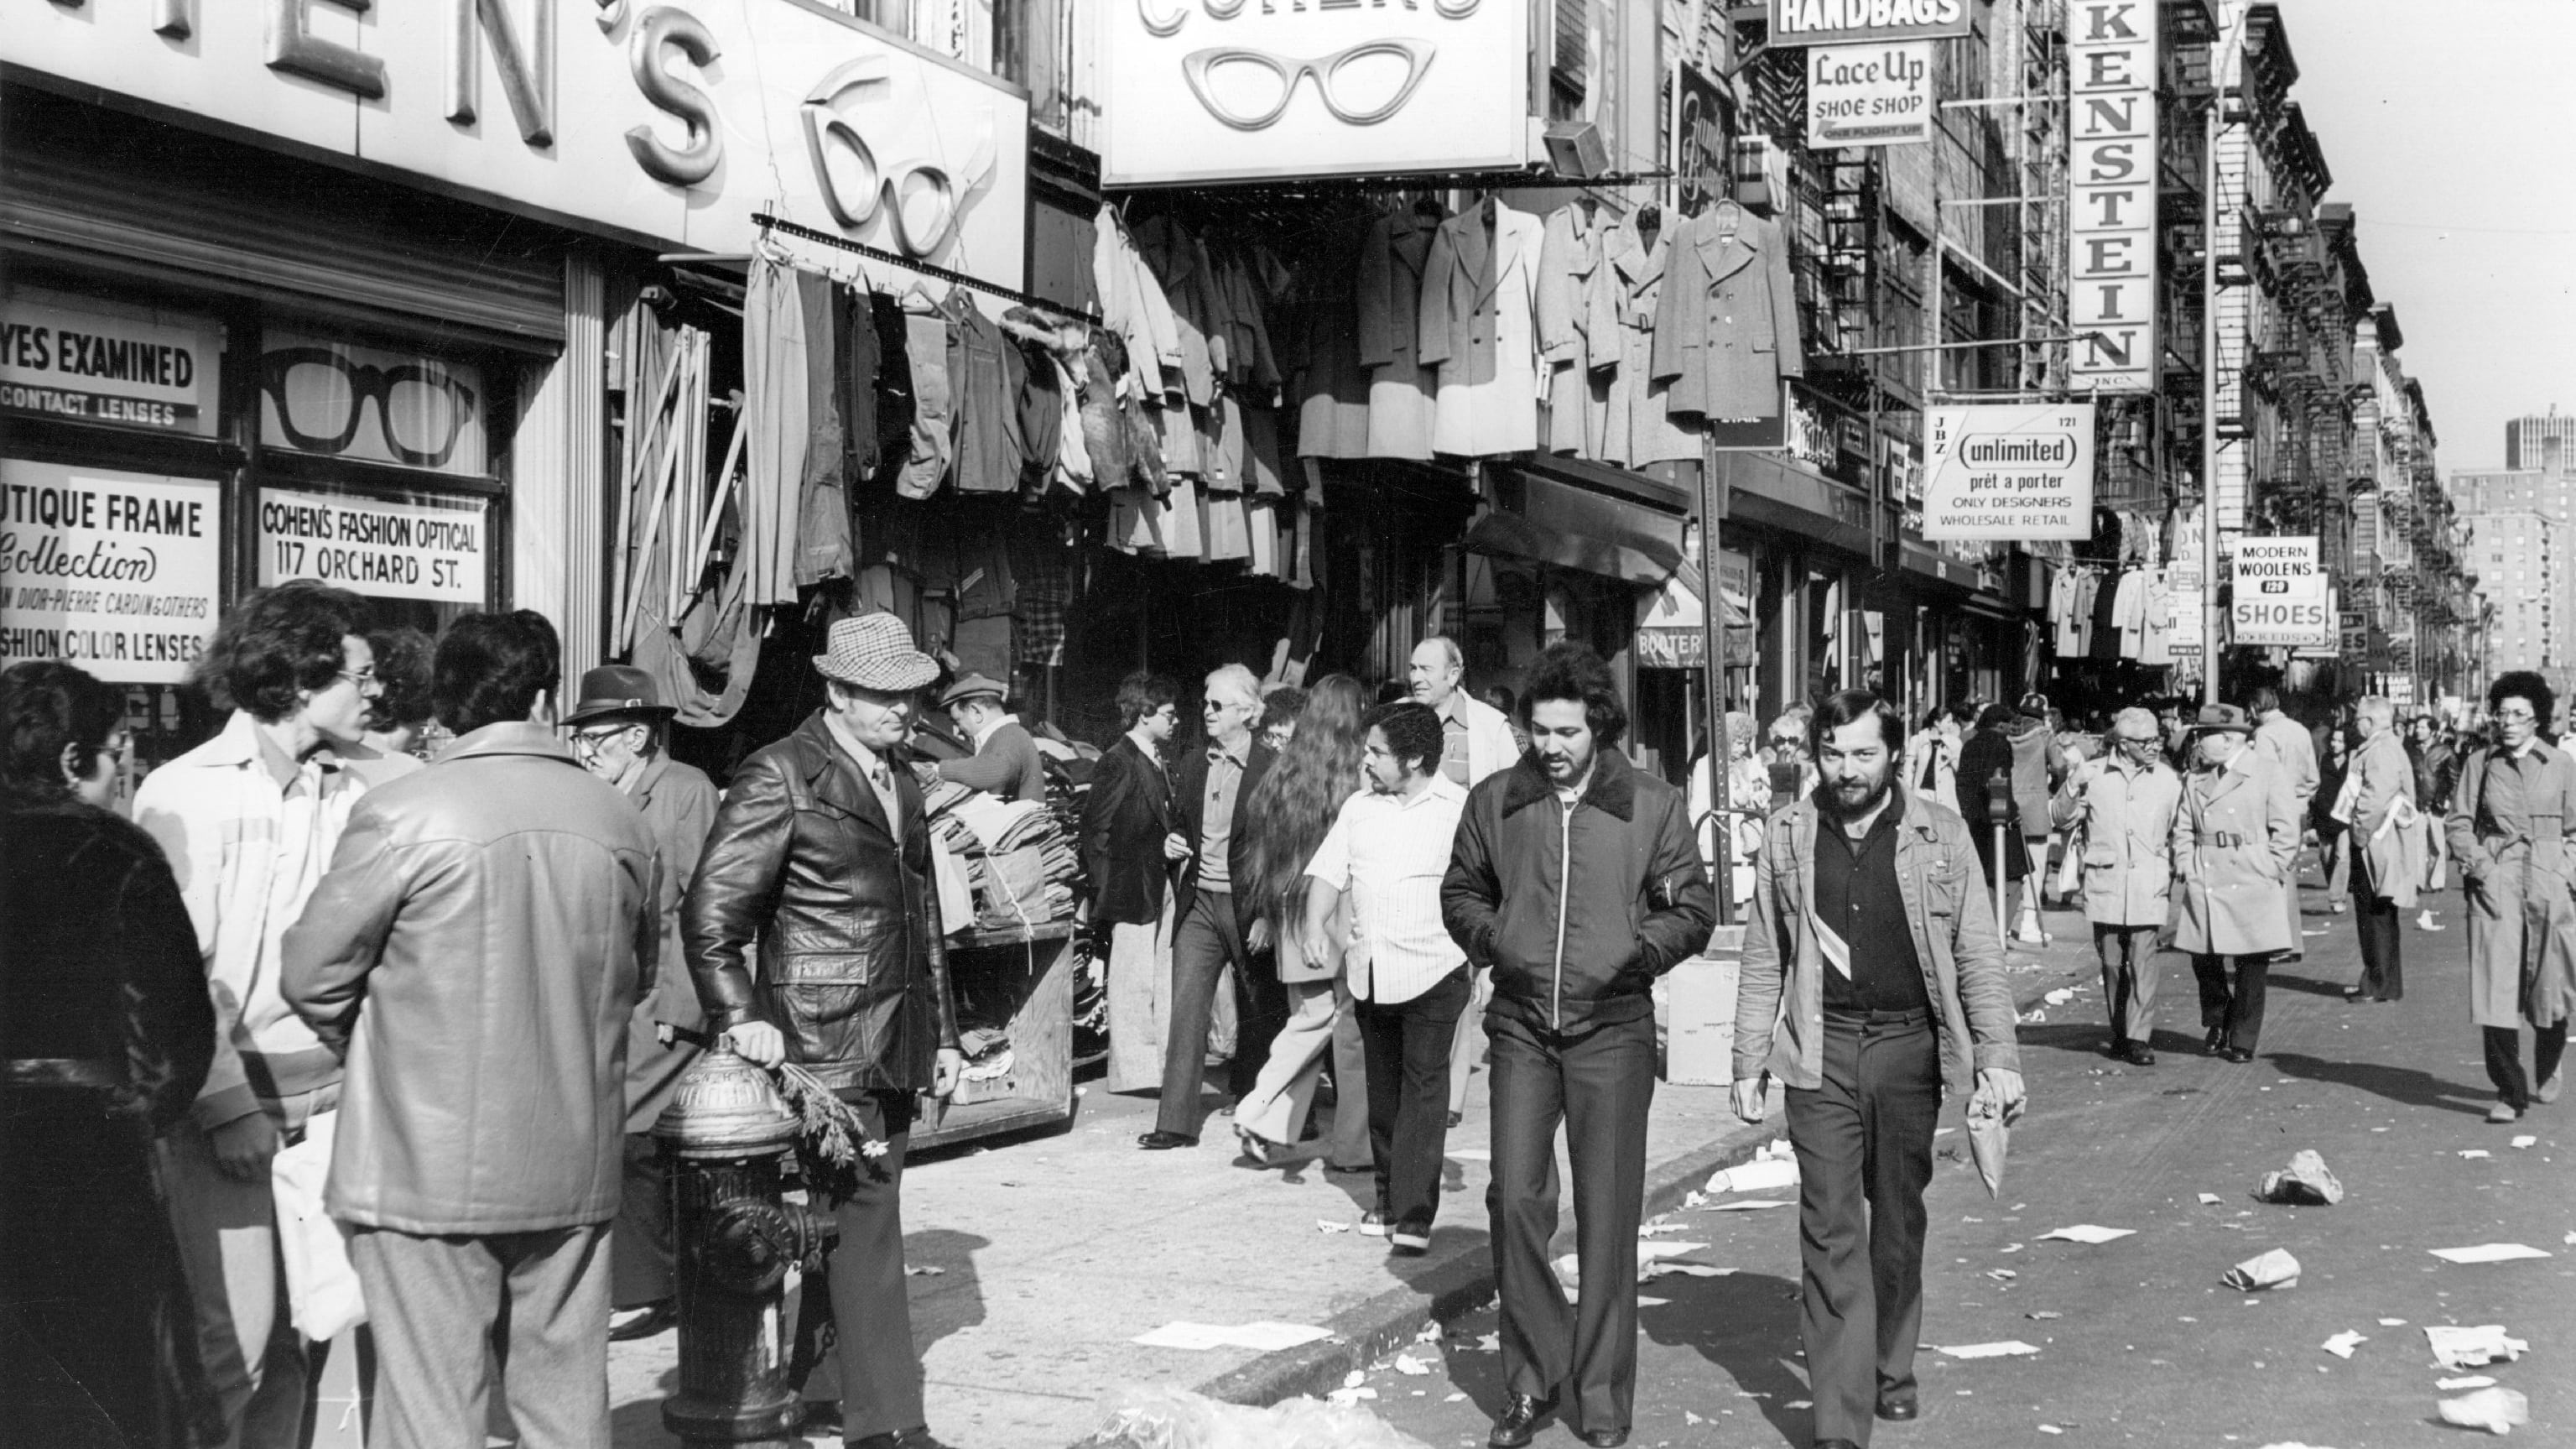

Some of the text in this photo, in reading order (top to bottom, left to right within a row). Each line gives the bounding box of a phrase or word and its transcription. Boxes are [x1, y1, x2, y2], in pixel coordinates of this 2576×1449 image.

[1779, 0, 1961, 32] HANDBAGS
[1814, 51, 1923, 91] Lace Up
[1814, 94, 1923, 118] SHOE SHOP
[59, 331, 193, 388] EXAMINED
[1, 386, 174, 425] CONTACT LENSES
[2059, 417, 2076, 427] 121
[2005, 476, 2012, 488] a
[2018, 474, 2063, 492] porter
[107, 494, 202, 537] FRAME
[1952, 497, 2072, 508] ONLY DESIGNERS
[262, 502, 477, 552] COHEN'S FASHION OPTICAL
[1940, 514, 2070, 526] WHOLESALE RETAIL
[0, 530, 157, 582] Collection
[277, 540, 461, 588] 117 ORCHARD ST.
[2242, 546, 2308, 558] MODERN
[2239, 562, 2311, 576] WOOLENS
[2236, 604, 2323, 624] SHOES
[65, 630, 127, 660] COLOR
[133, 633, 202, 662] LENSES
[1639, 633, 1703, 655] BOOTER
